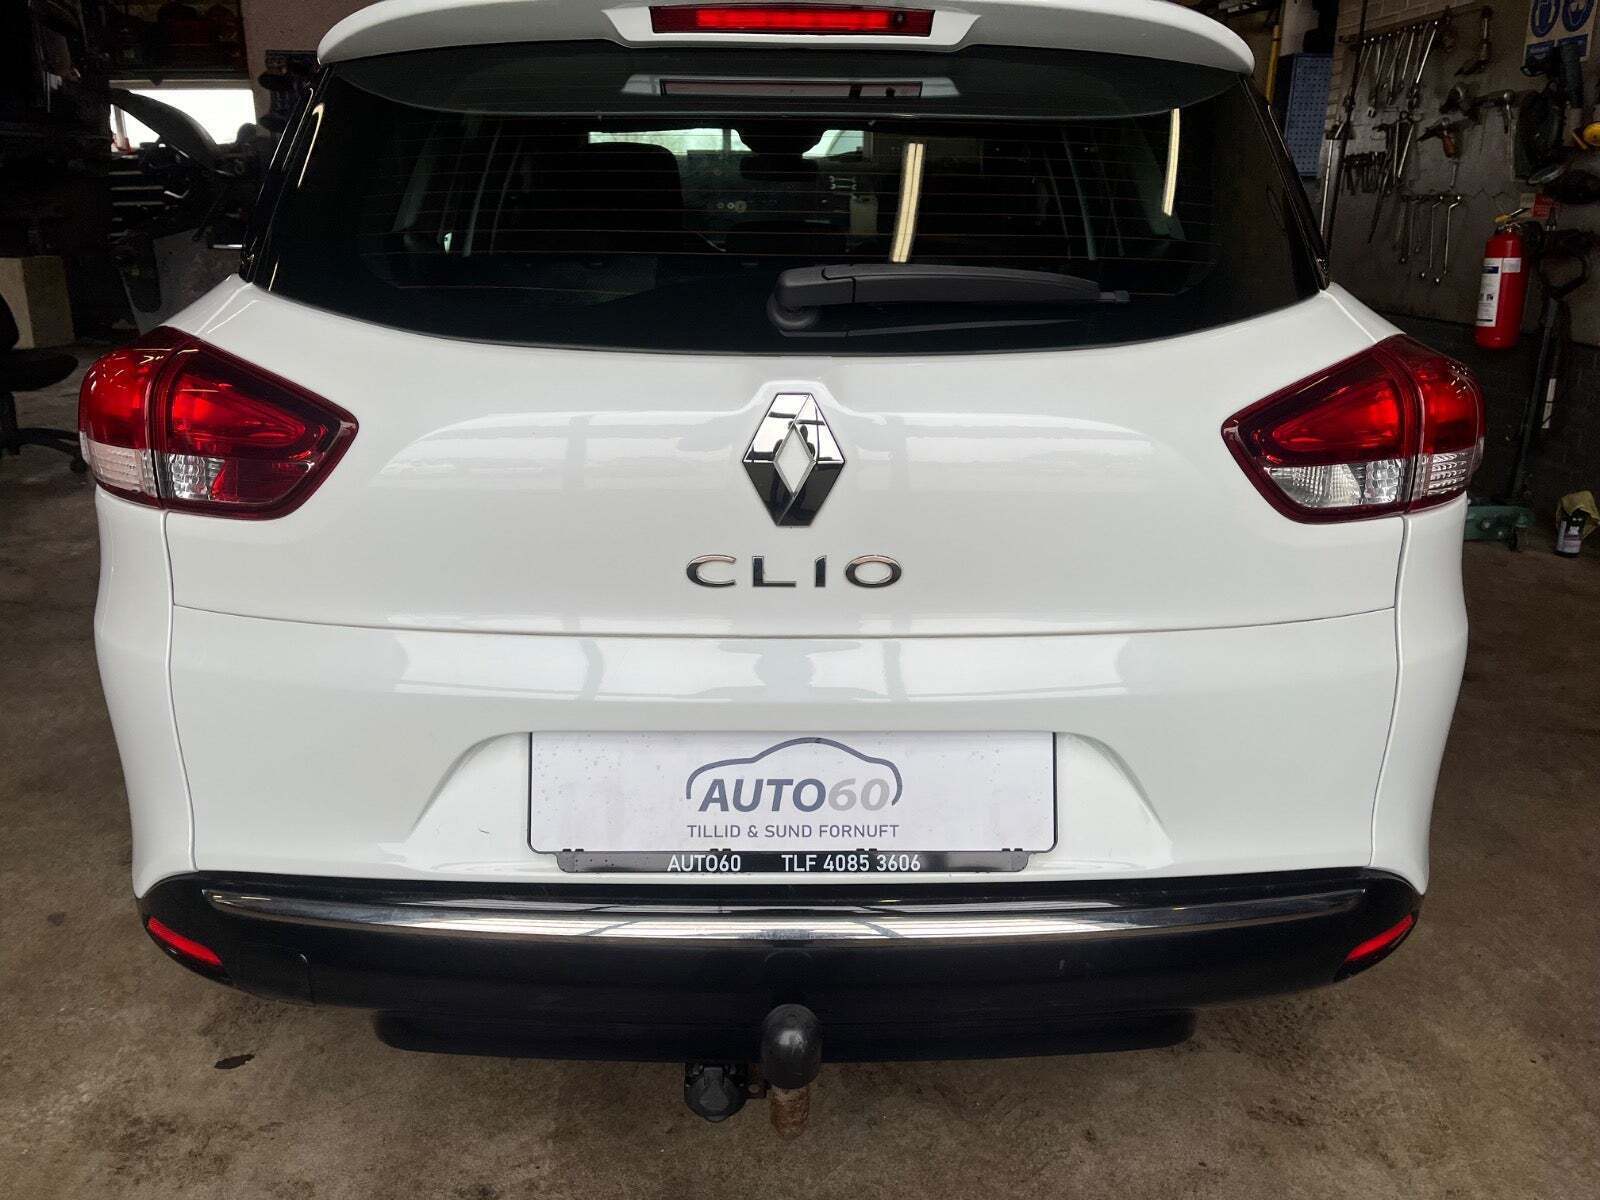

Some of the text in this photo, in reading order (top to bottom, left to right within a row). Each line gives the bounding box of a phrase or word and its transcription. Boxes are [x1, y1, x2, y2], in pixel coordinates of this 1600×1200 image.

[687, 554, 902, 588] CLIO
[699, 778, 890, 812] AUTO60
[687, 824, 900, 839] TILLID & SUND FORNUFT
[667, 854, 921, 872] AUTO60 TLF 4085 3606
